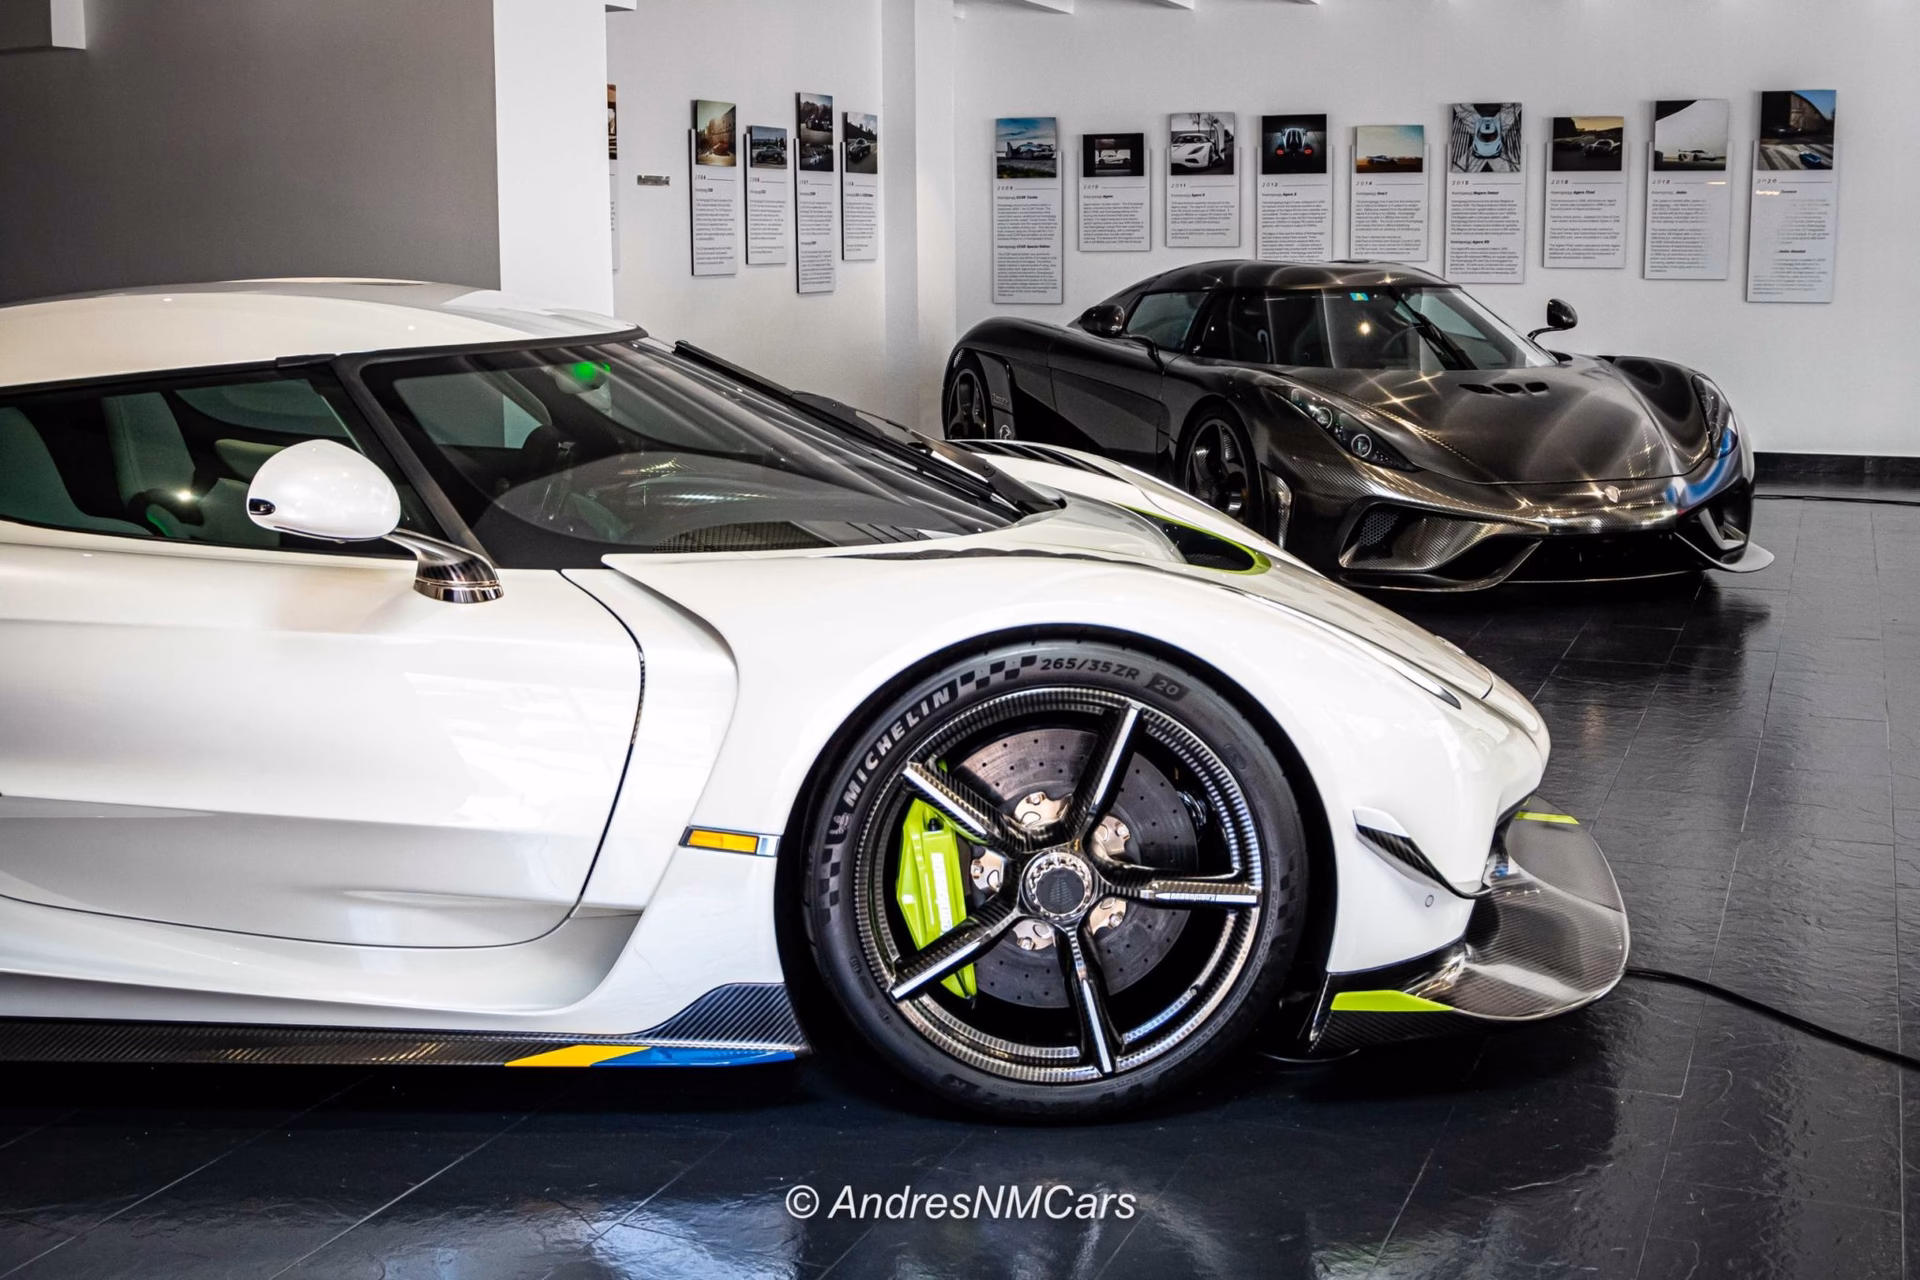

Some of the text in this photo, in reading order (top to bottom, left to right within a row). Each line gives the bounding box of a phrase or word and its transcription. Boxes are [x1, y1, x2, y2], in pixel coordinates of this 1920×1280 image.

[1040, 657, 1180, 696] 265/35ZR 20
[842, 686, 951, 808] MICHELIN
